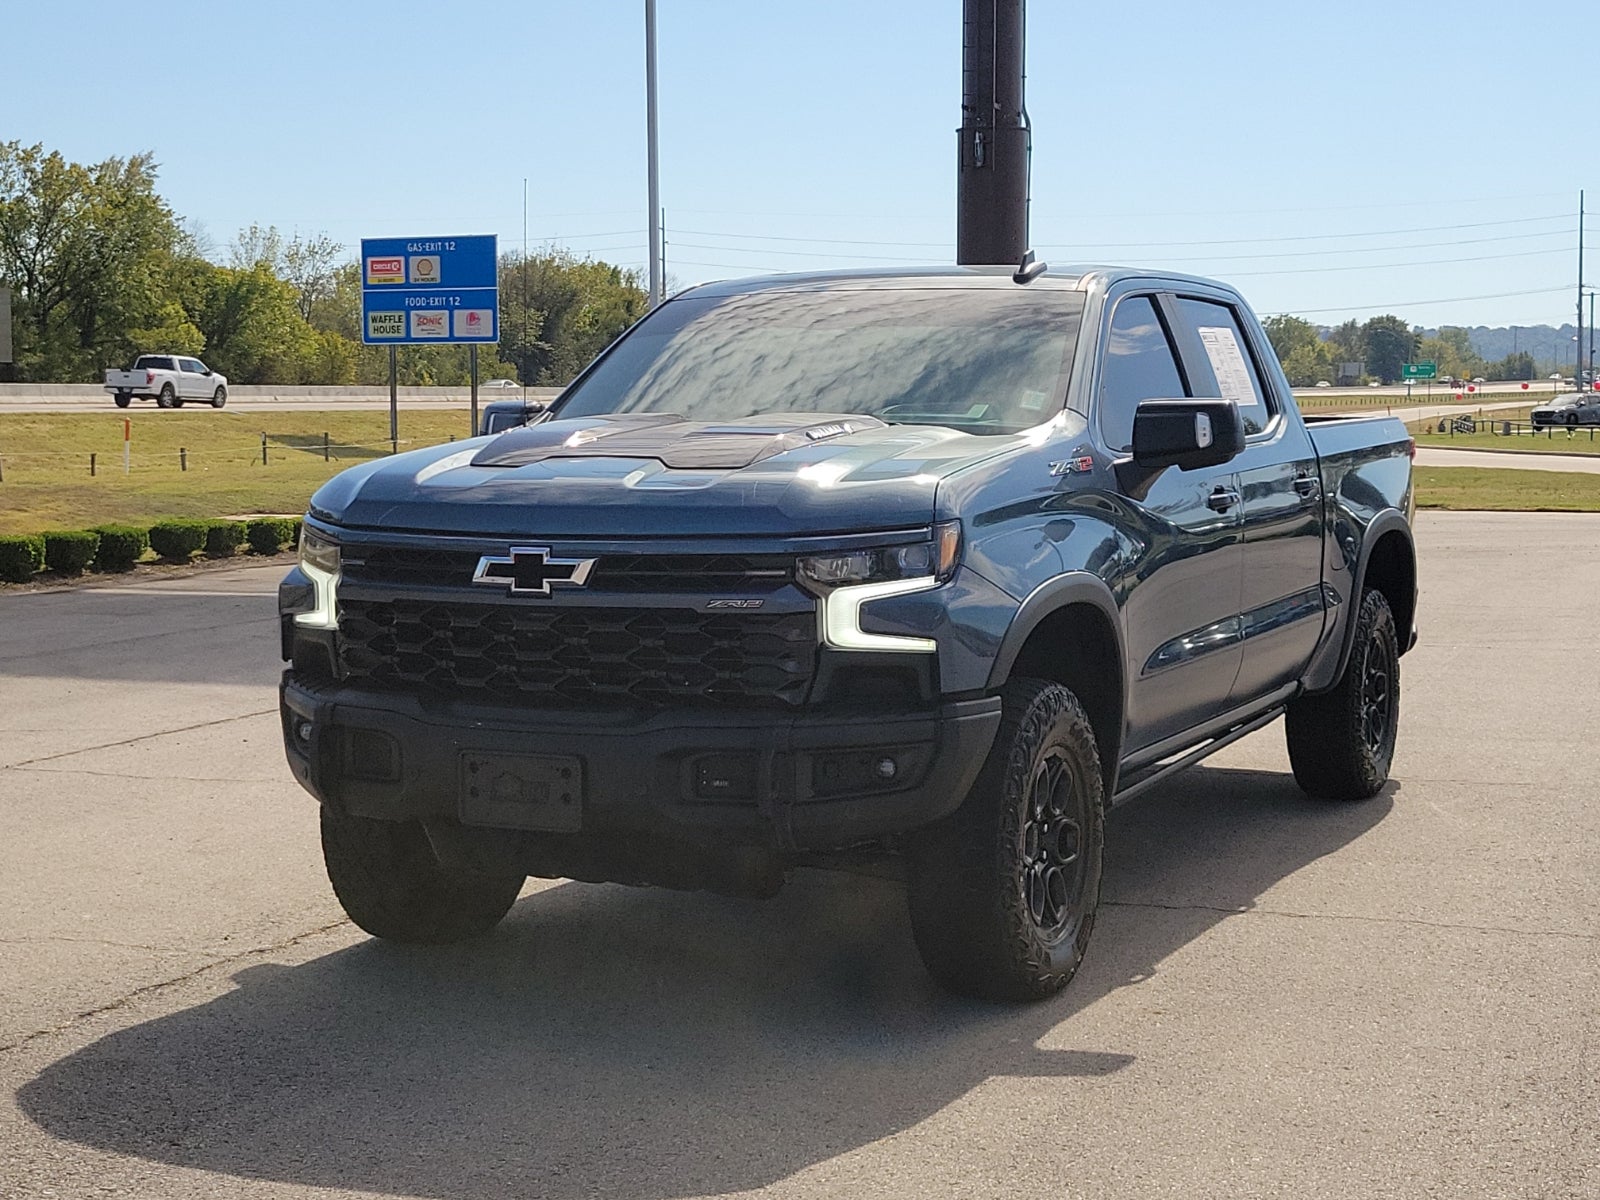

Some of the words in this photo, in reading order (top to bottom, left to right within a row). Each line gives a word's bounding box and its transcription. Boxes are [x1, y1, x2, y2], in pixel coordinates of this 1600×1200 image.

[407, 242, 442, 252] GAS-EXIT
[445, 241, 456, 251] 12
[405, 297, 446, 306] FOOD-EXIT
[449, 296, 460, 306] 12
[370, 314, 404, 324] WAFFLE
[417, 317, 442, 326] SONIC
[373, 325, 401, 334] HOUSE
